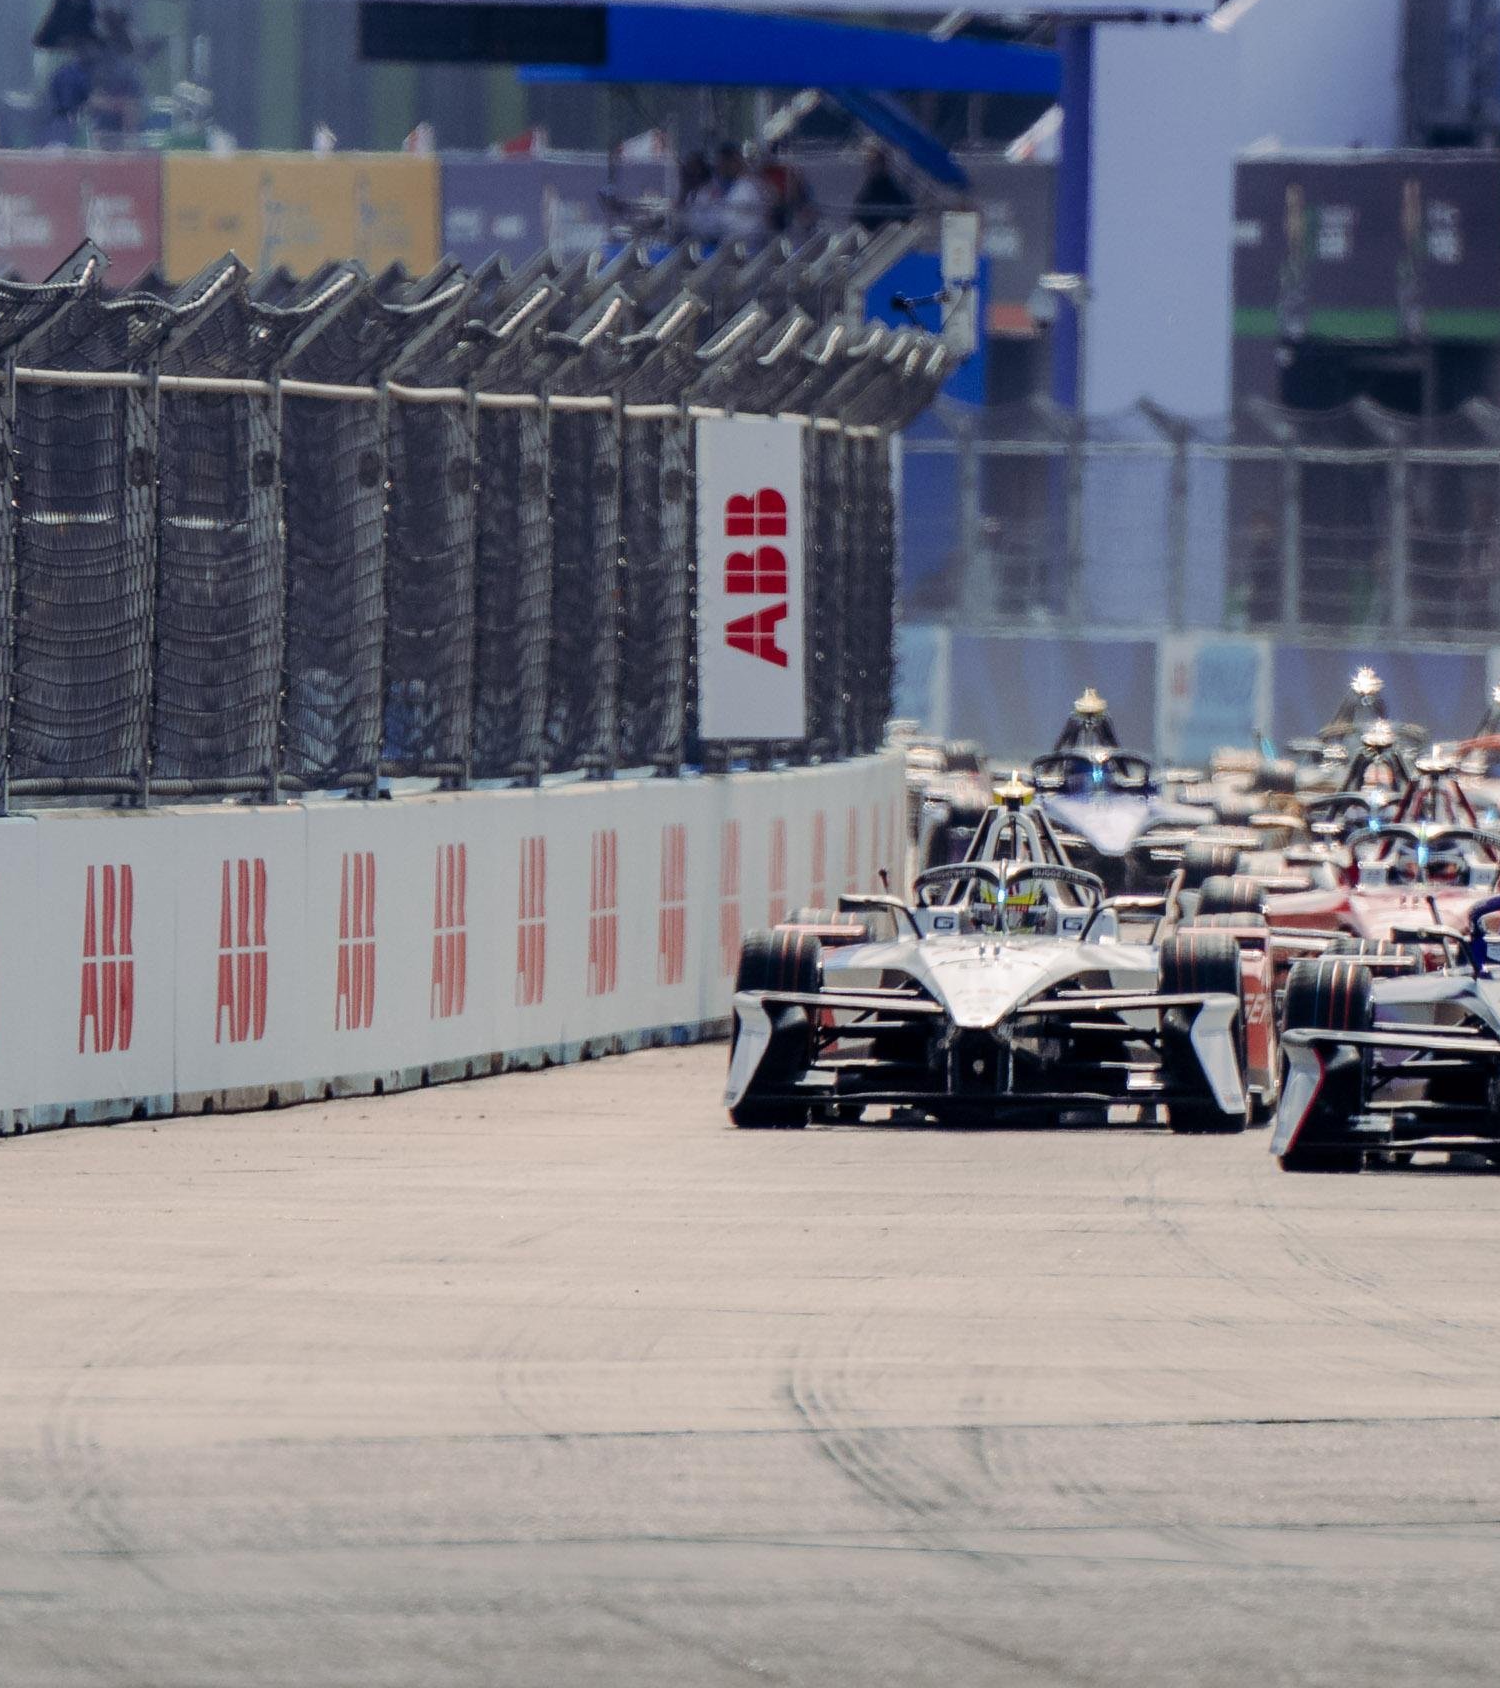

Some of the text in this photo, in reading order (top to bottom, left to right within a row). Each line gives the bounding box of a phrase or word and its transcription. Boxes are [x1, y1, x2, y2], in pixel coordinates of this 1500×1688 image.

[723, 486, 790, 669] ABB
[78, 863, 135, 1055] ABB
[215, 858, 269, 1045] ABB
